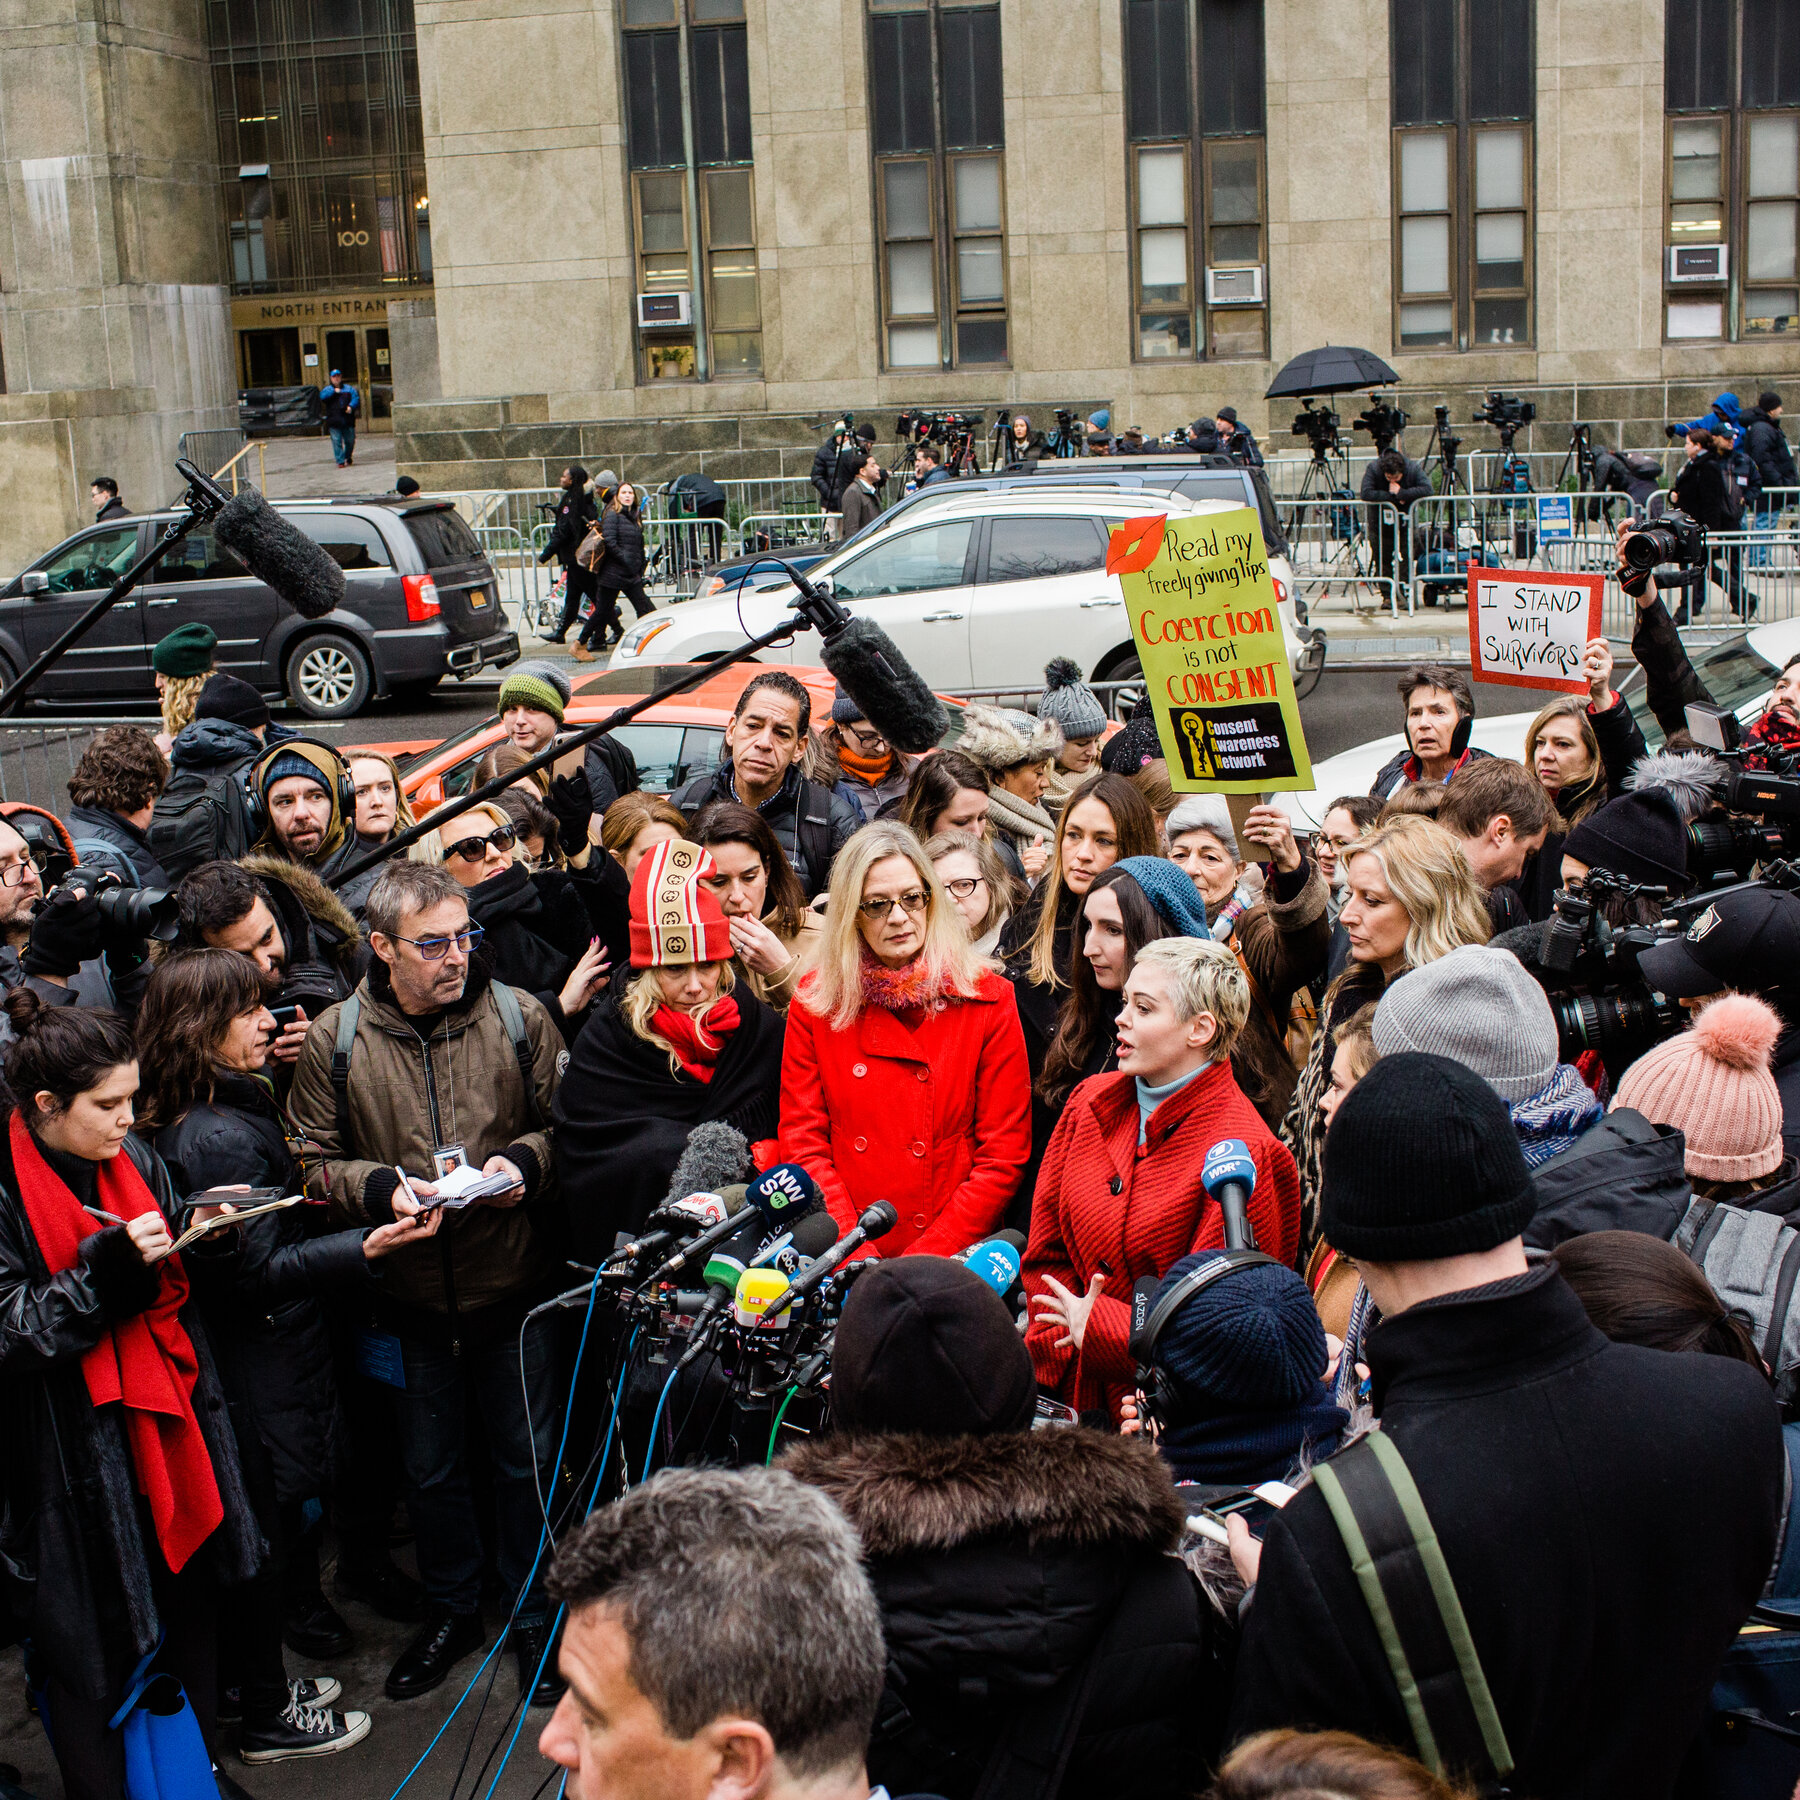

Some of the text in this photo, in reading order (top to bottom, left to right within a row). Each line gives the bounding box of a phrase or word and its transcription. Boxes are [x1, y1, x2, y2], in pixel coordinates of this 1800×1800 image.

[337, 230, 369, 247] 100
[261, 298, 404, 318] NORTH ENTRAN
[1163, 528, 1252, 562] Read my
[1480, 585, 1582, 614] I STAND
[1140, 604, 1275, 646] Coercion
[1507, 616, 1549, 637] WITH
[1182, 640, 1239, 668] is not
[1166, 662, 1281, 706] CONSENT
[1206, 718, 1259, 736] Consent
[1210, 734, 1280, 752] Awareness
[1214, 752, 1267, 769] Network
[1208, 1161, 1237, 1179] WDR
[781, 1251, 797, 1274] abc
[989, 1251, 1013, 1271] AFP
[991, 1265, 1005, 1282] TV
